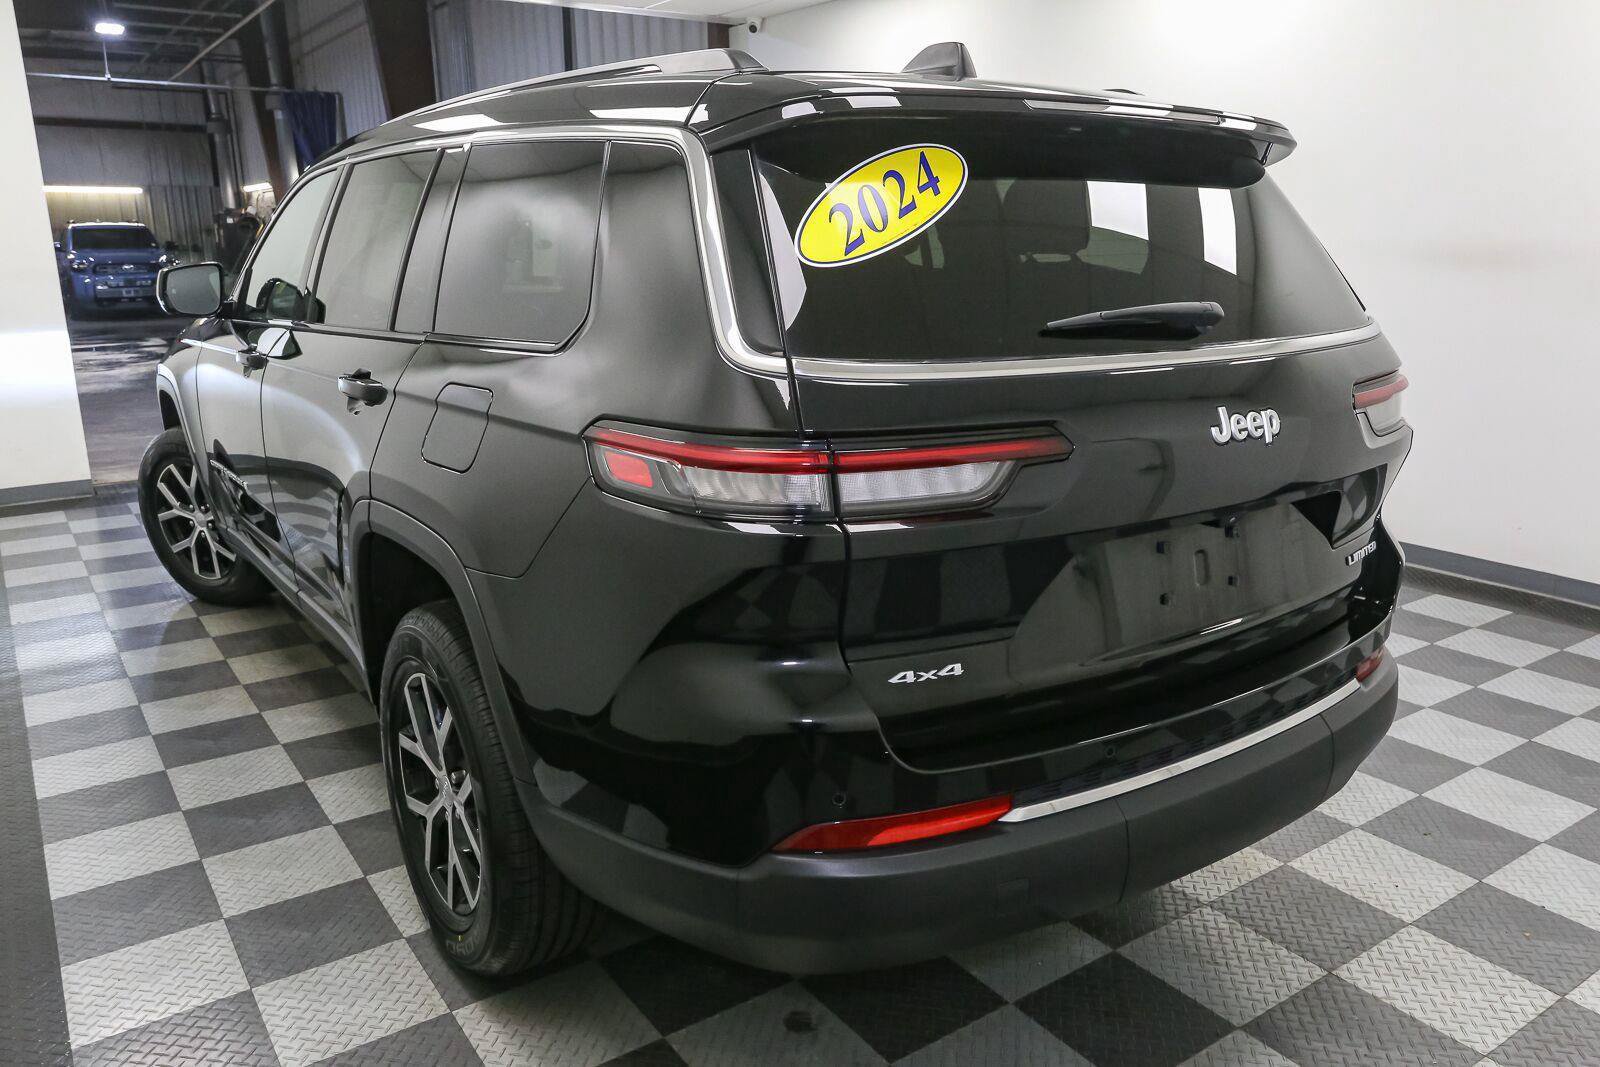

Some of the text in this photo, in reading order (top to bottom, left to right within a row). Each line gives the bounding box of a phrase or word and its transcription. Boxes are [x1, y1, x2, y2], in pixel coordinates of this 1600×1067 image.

[829, 151, 941, 256] 2024
[1210, 406, 1281, 444] Jeep
[1347, 541, 1377, 566] LIMITED
[887, 663, 964, 683] 4x4
